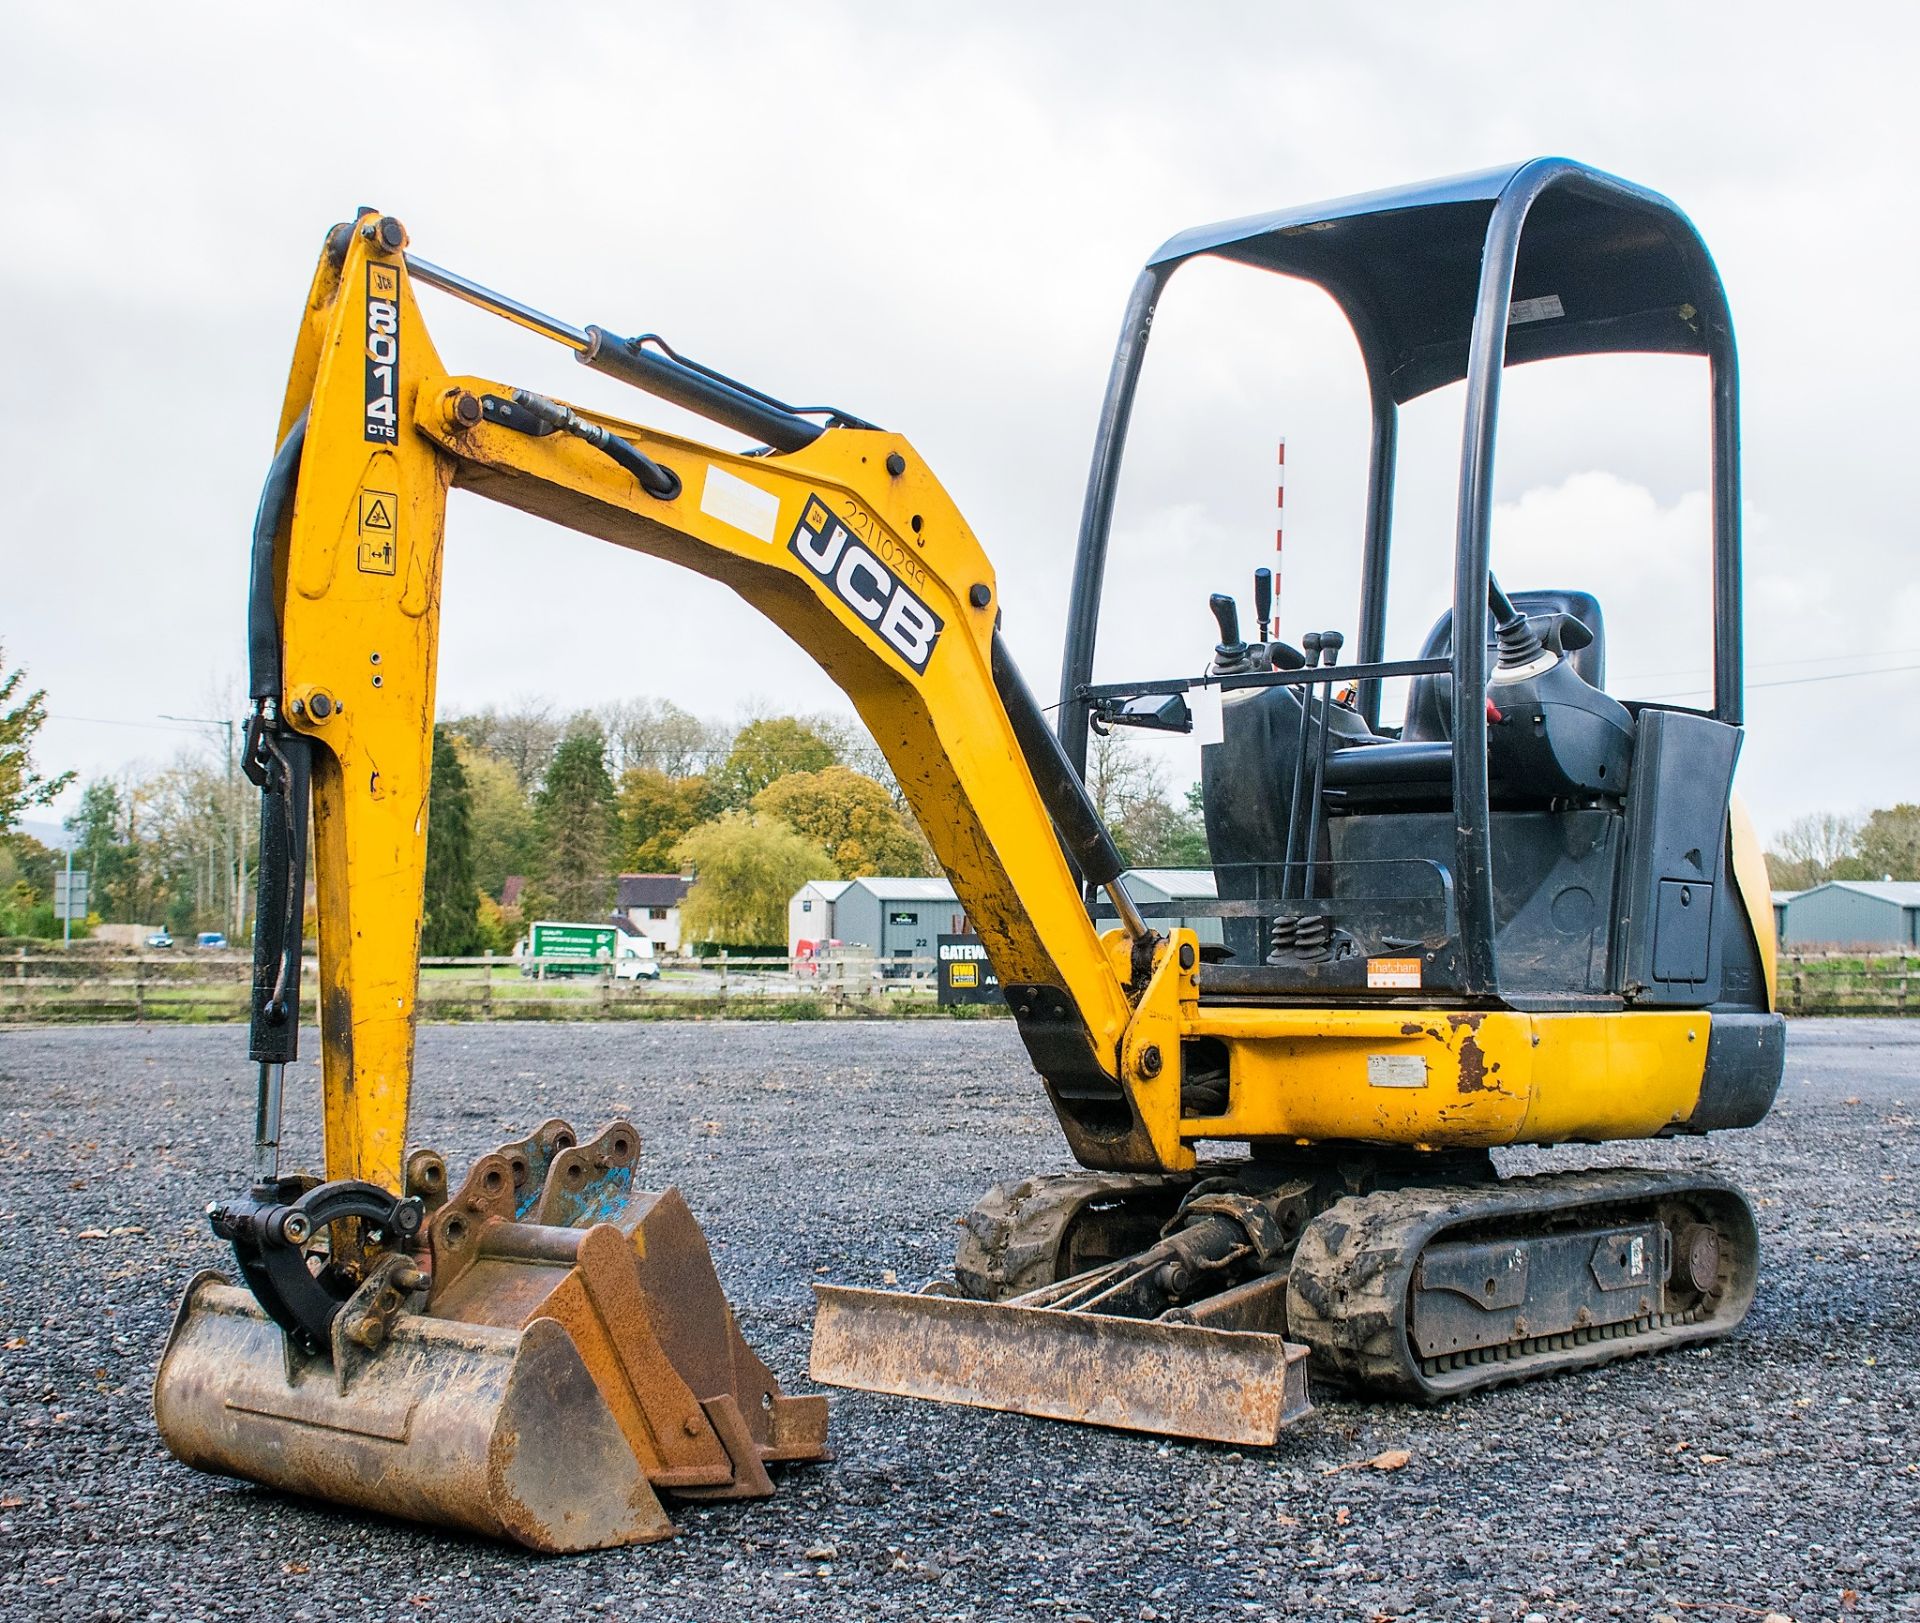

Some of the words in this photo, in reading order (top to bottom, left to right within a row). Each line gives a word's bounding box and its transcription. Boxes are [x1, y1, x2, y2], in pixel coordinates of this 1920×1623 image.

[367, 301, 397, 427] 8014
[367, 424, 396, 438] CTS
[796, 524, 936, 665] JCB
[916, 939, 927, 947] 22
